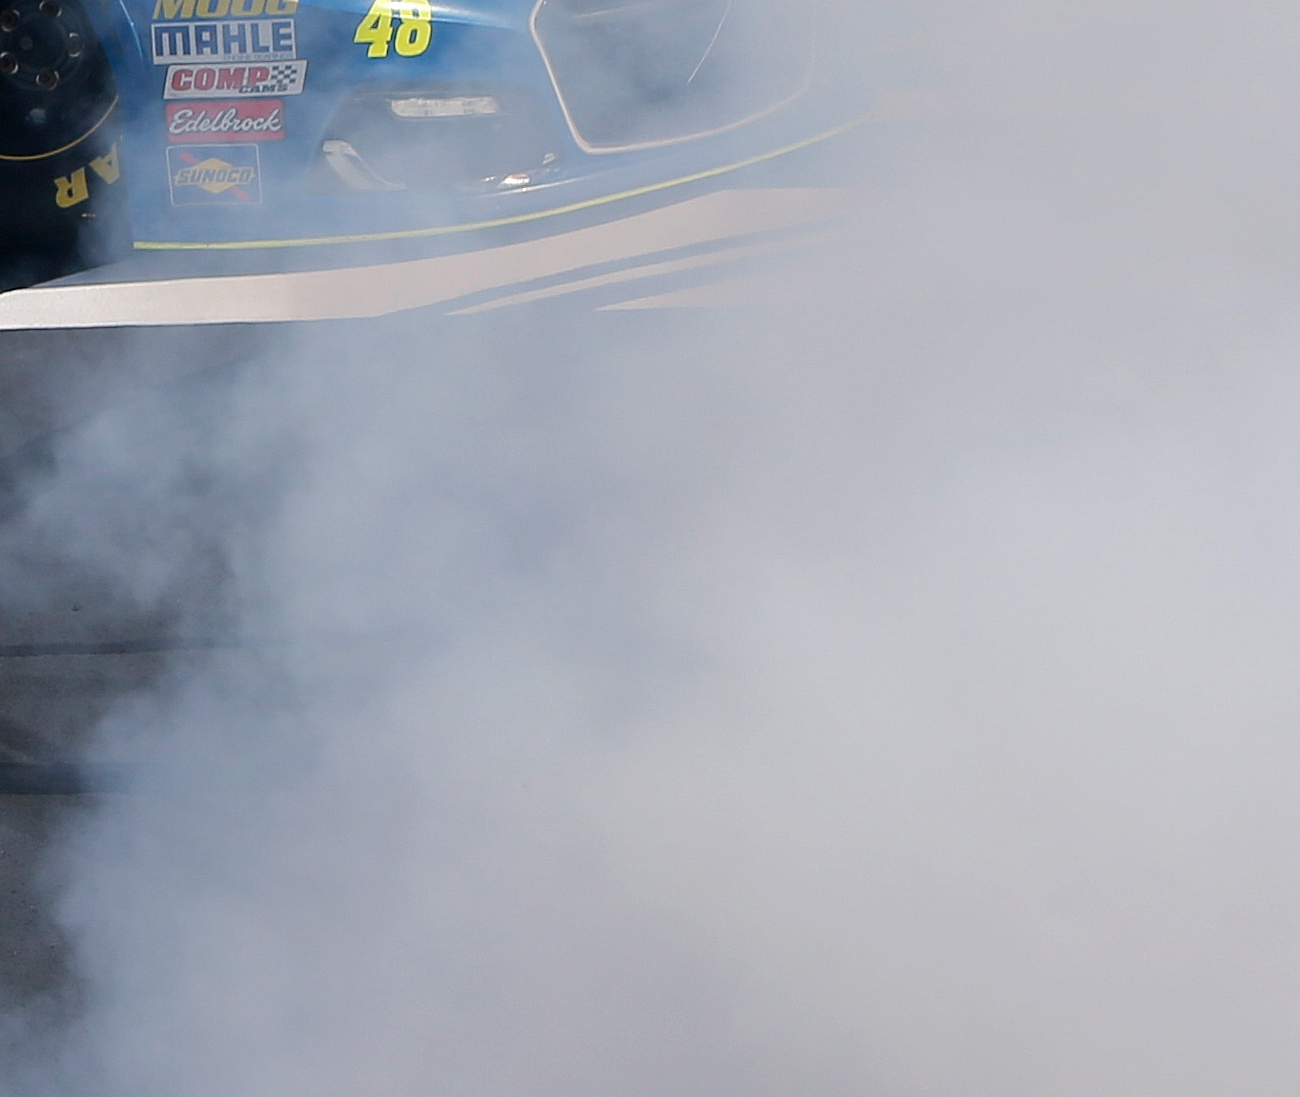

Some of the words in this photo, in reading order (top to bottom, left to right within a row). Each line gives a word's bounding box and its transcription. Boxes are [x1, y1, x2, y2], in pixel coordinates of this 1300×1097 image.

[154, 20, 295, 57] MAHLE
[170, 66, 270, 92] COMP
[238, 83, 289, 94] CAMS
[168, 107, 283, 135] Edelbrock
[176, 167, 253, 185] SUNOCO
